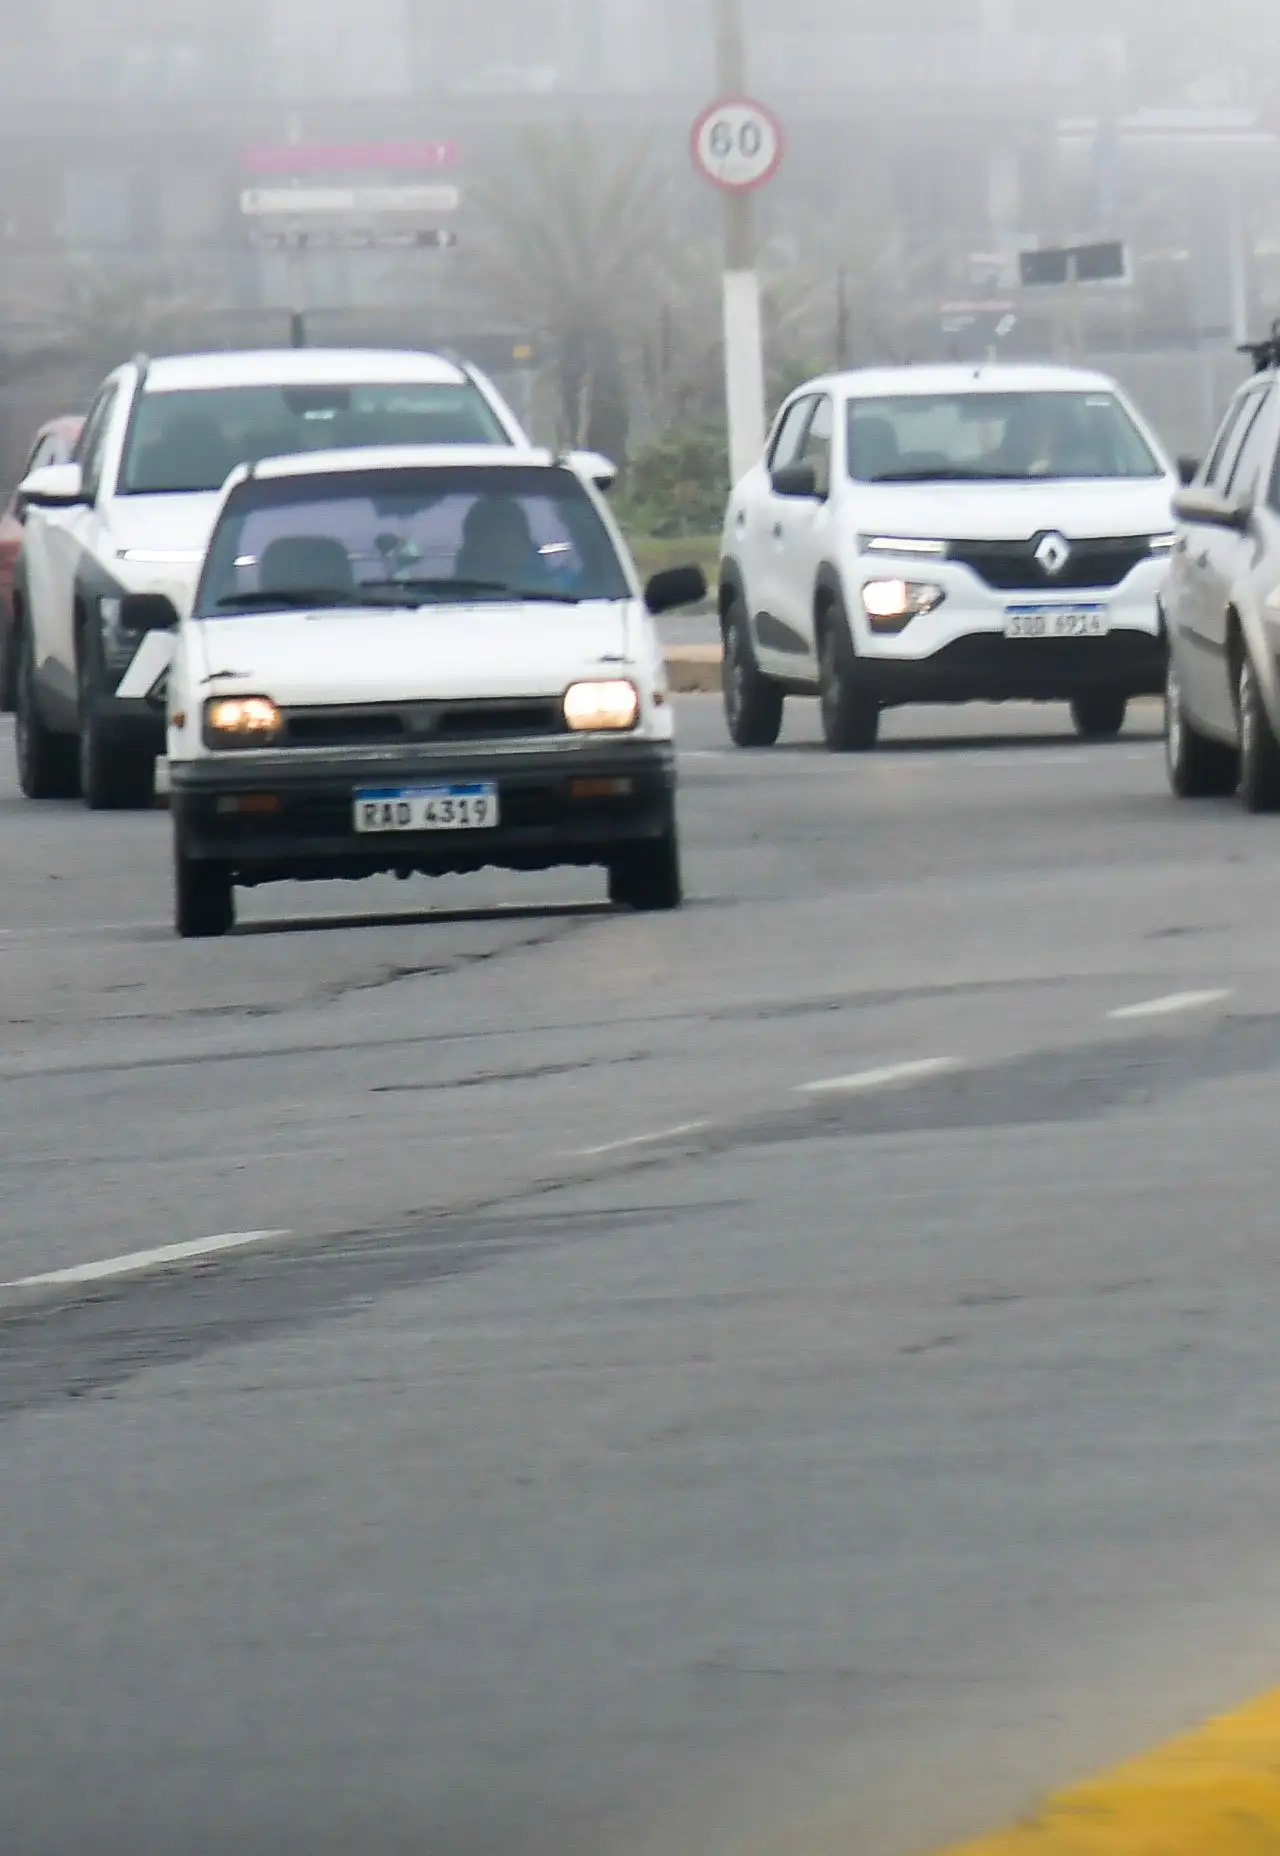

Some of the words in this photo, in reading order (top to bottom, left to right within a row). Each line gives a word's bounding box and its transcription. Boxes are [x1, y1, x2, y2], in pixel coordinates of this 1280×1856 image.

[709, 120, 763, 159] 60
[363, 803, 412, 826] RAD
[424, 799, 488, 824] 4319
